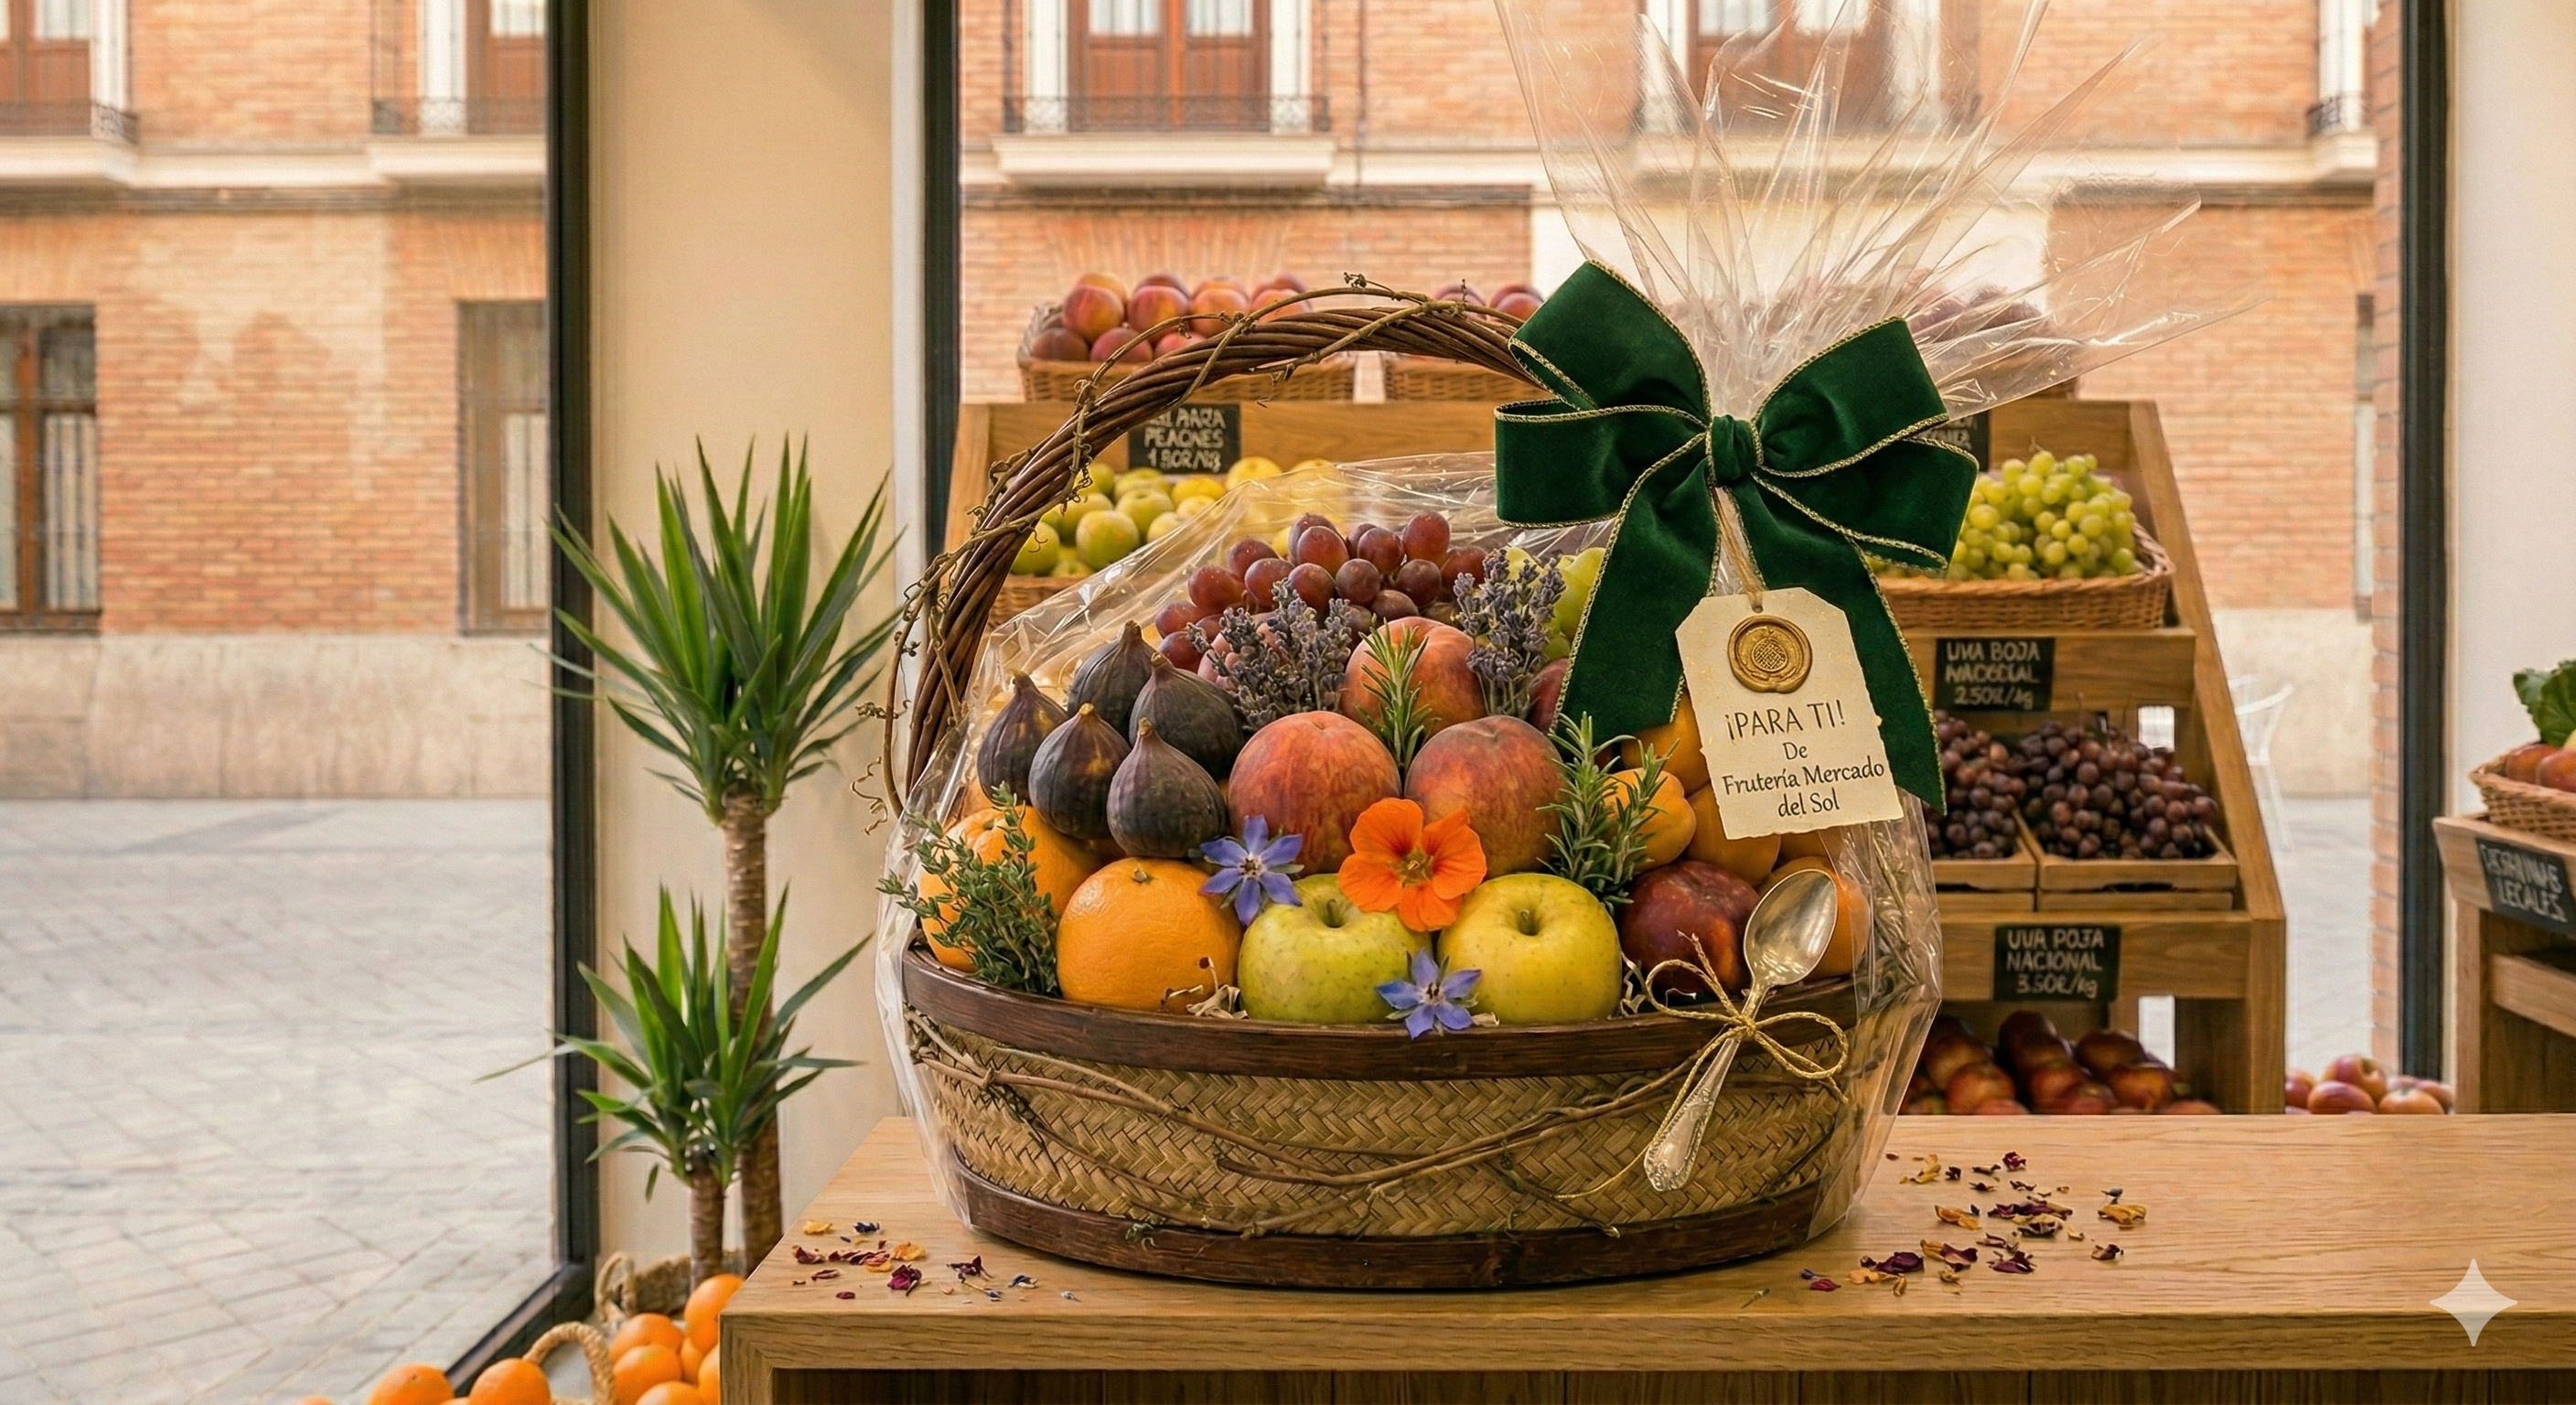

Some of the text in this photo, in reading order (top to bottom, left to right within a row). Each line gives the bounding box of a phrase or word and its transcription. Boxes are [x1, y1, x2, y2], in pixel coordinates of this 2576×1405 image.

[1724, 700, 1845, 740] ¡PARA TI!
[1783, 742, 1808, 760] De
[1722, 755, 1884, 795] Frutería Mercado
[1777, 788, 1841, 818] del Sol
[2007, 928, 2047, 949] UVA
[2006, 950, 2103, 971] NACIONAL
